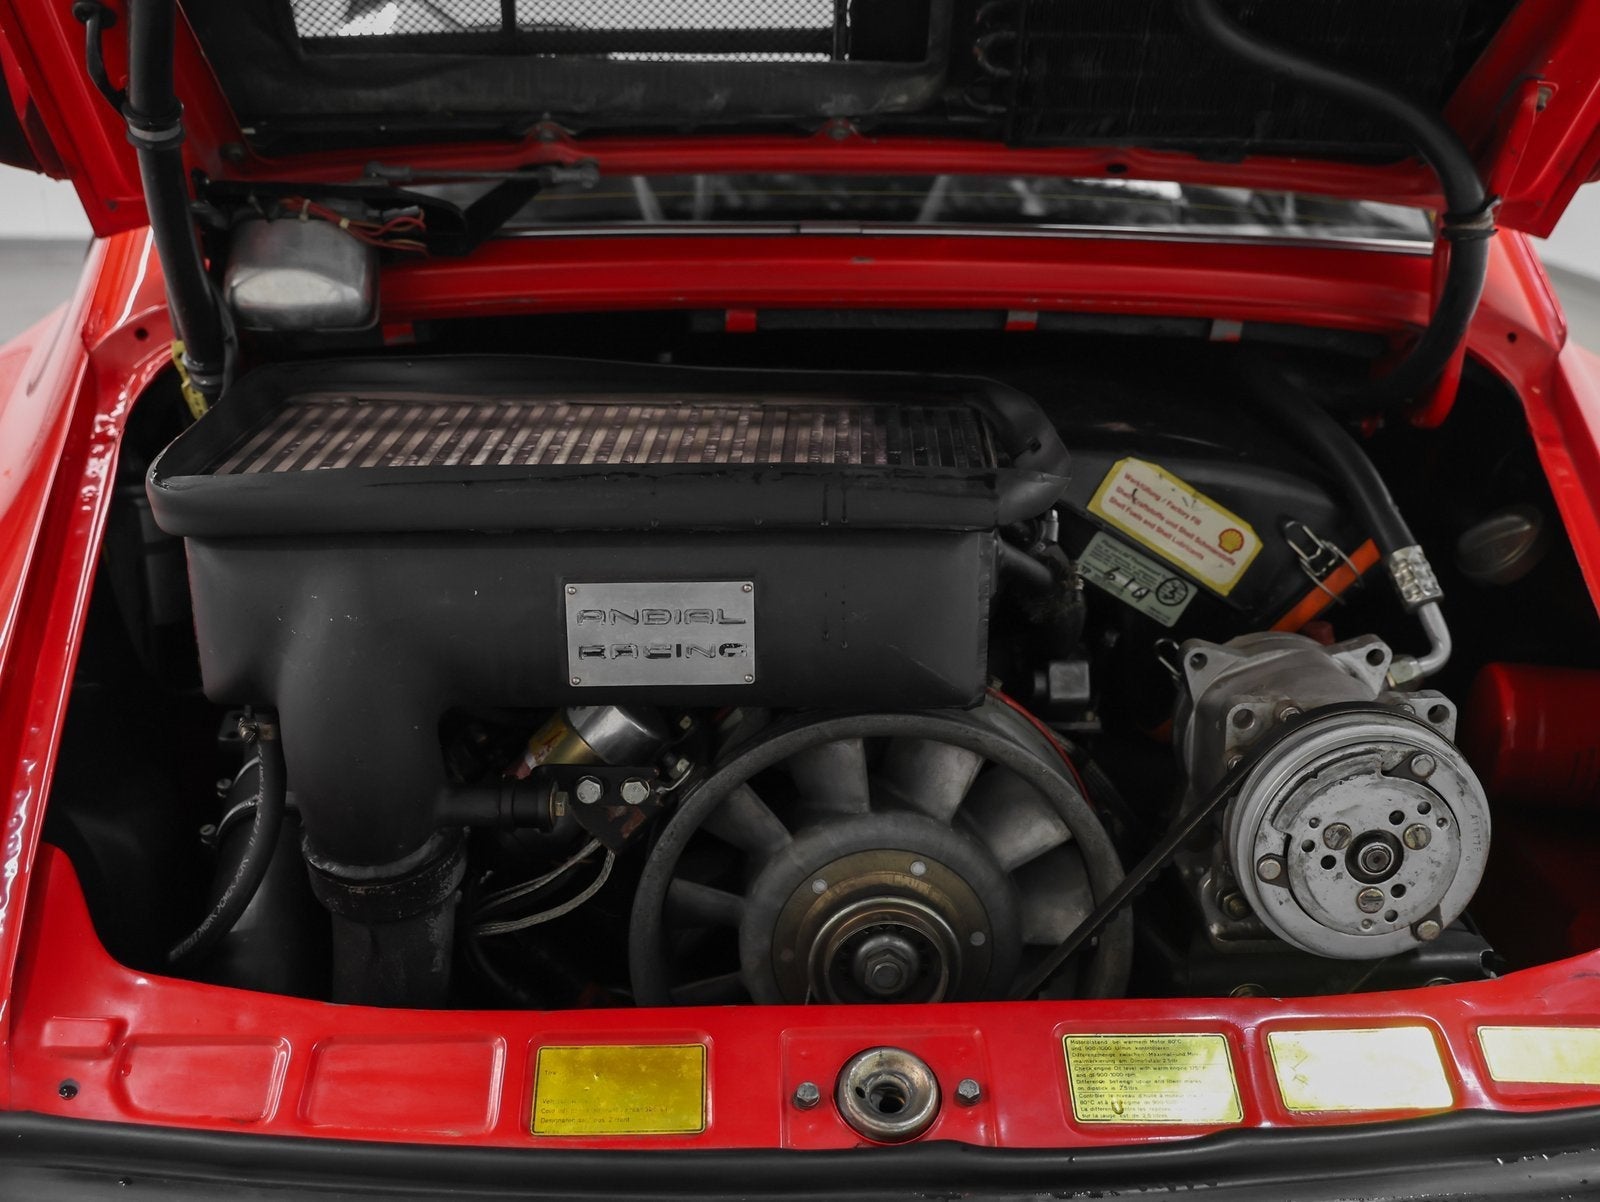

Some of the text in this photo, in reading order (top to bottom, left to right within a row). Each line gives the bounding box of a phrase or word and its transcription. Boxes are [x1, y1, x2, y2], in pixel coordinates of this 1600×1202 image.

[1165, 501, 1190, 519] Factory
[1190, 516, 1201, 525] Fill
[1109, 497, 1205, 560] Shell Fuels and Shell Lubricants
[1165, 519, 1178, 529] und
[1178, 527, 1194, 539] Shell
[576, 608, 746, 626] ANDIAL
[578, 642, 748, 660] RACING
